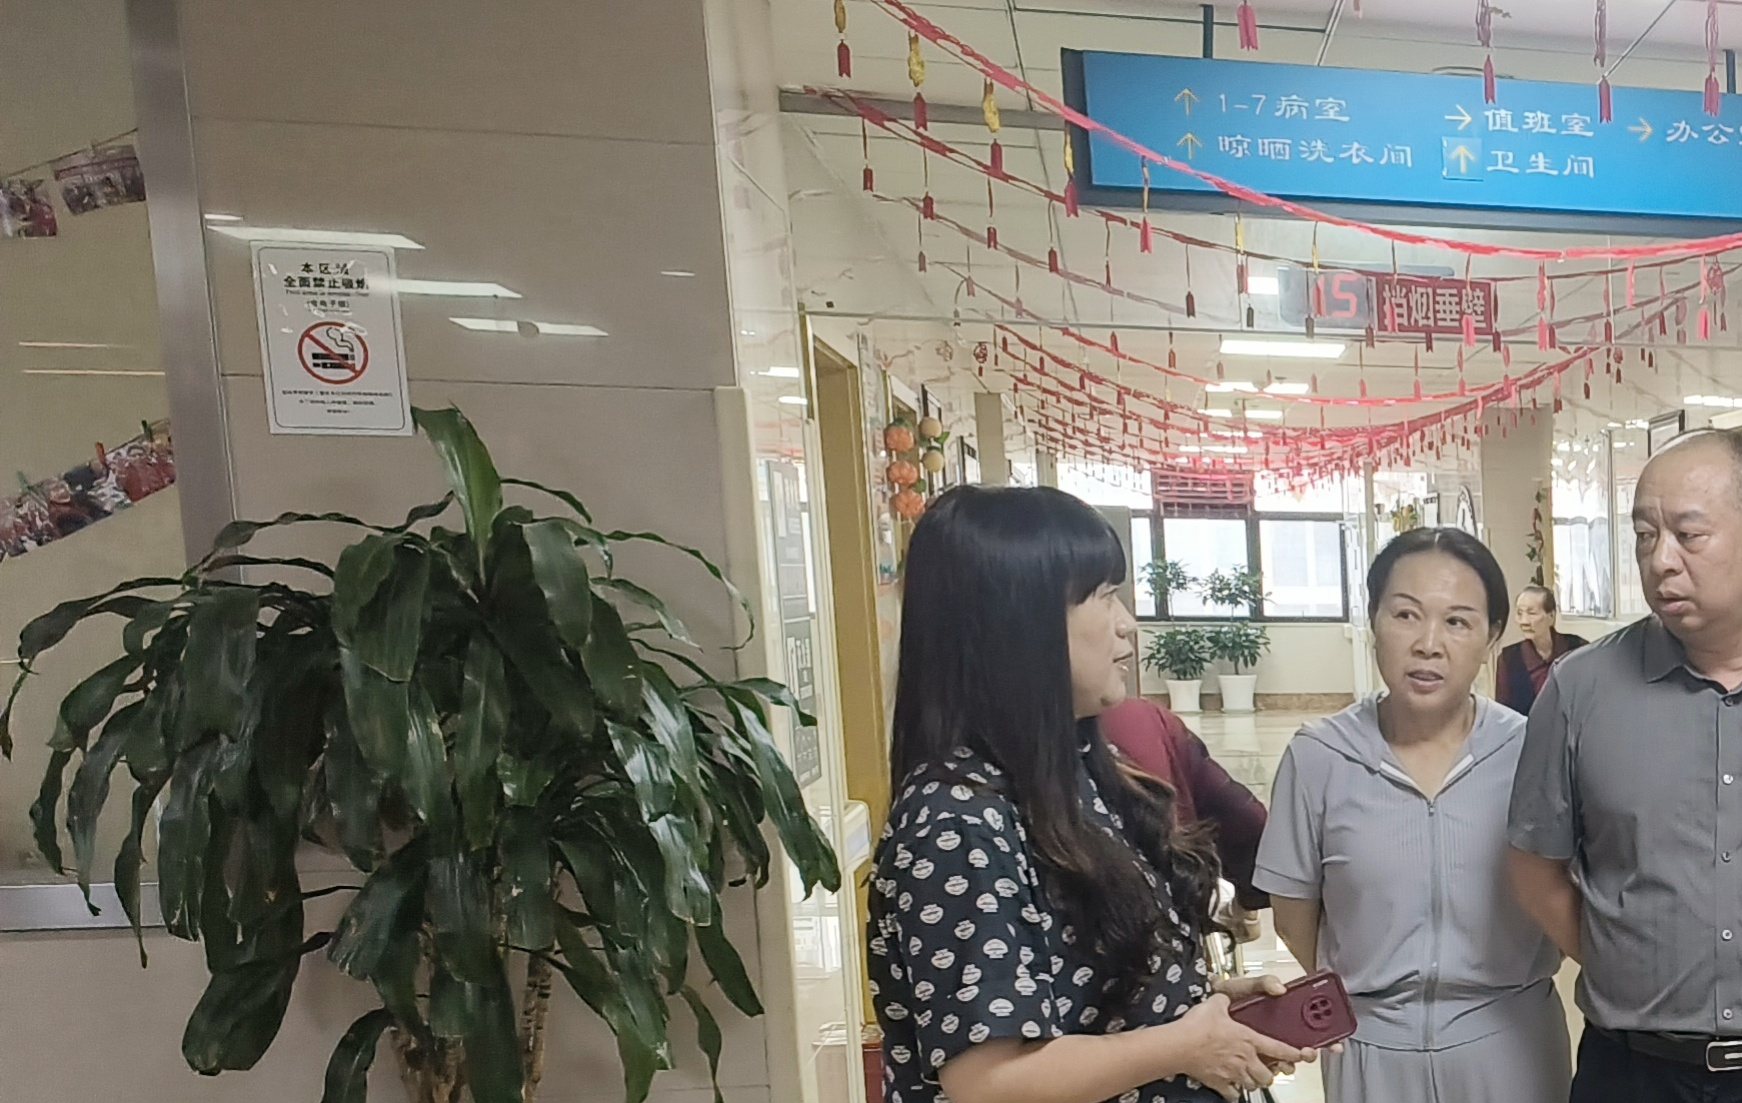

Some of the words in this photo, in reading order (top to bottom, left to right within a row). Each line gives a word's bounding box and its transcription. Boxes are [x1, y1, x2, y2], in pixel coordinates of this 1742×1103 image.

[1218, 93, 1351, 122] 1-7病室
[1483, 108, 1595, 138] 值班室
[1218, 134, 1413, 168] 晾晒洗衣间
[1486, 149, 1595, 179] 卫生间
